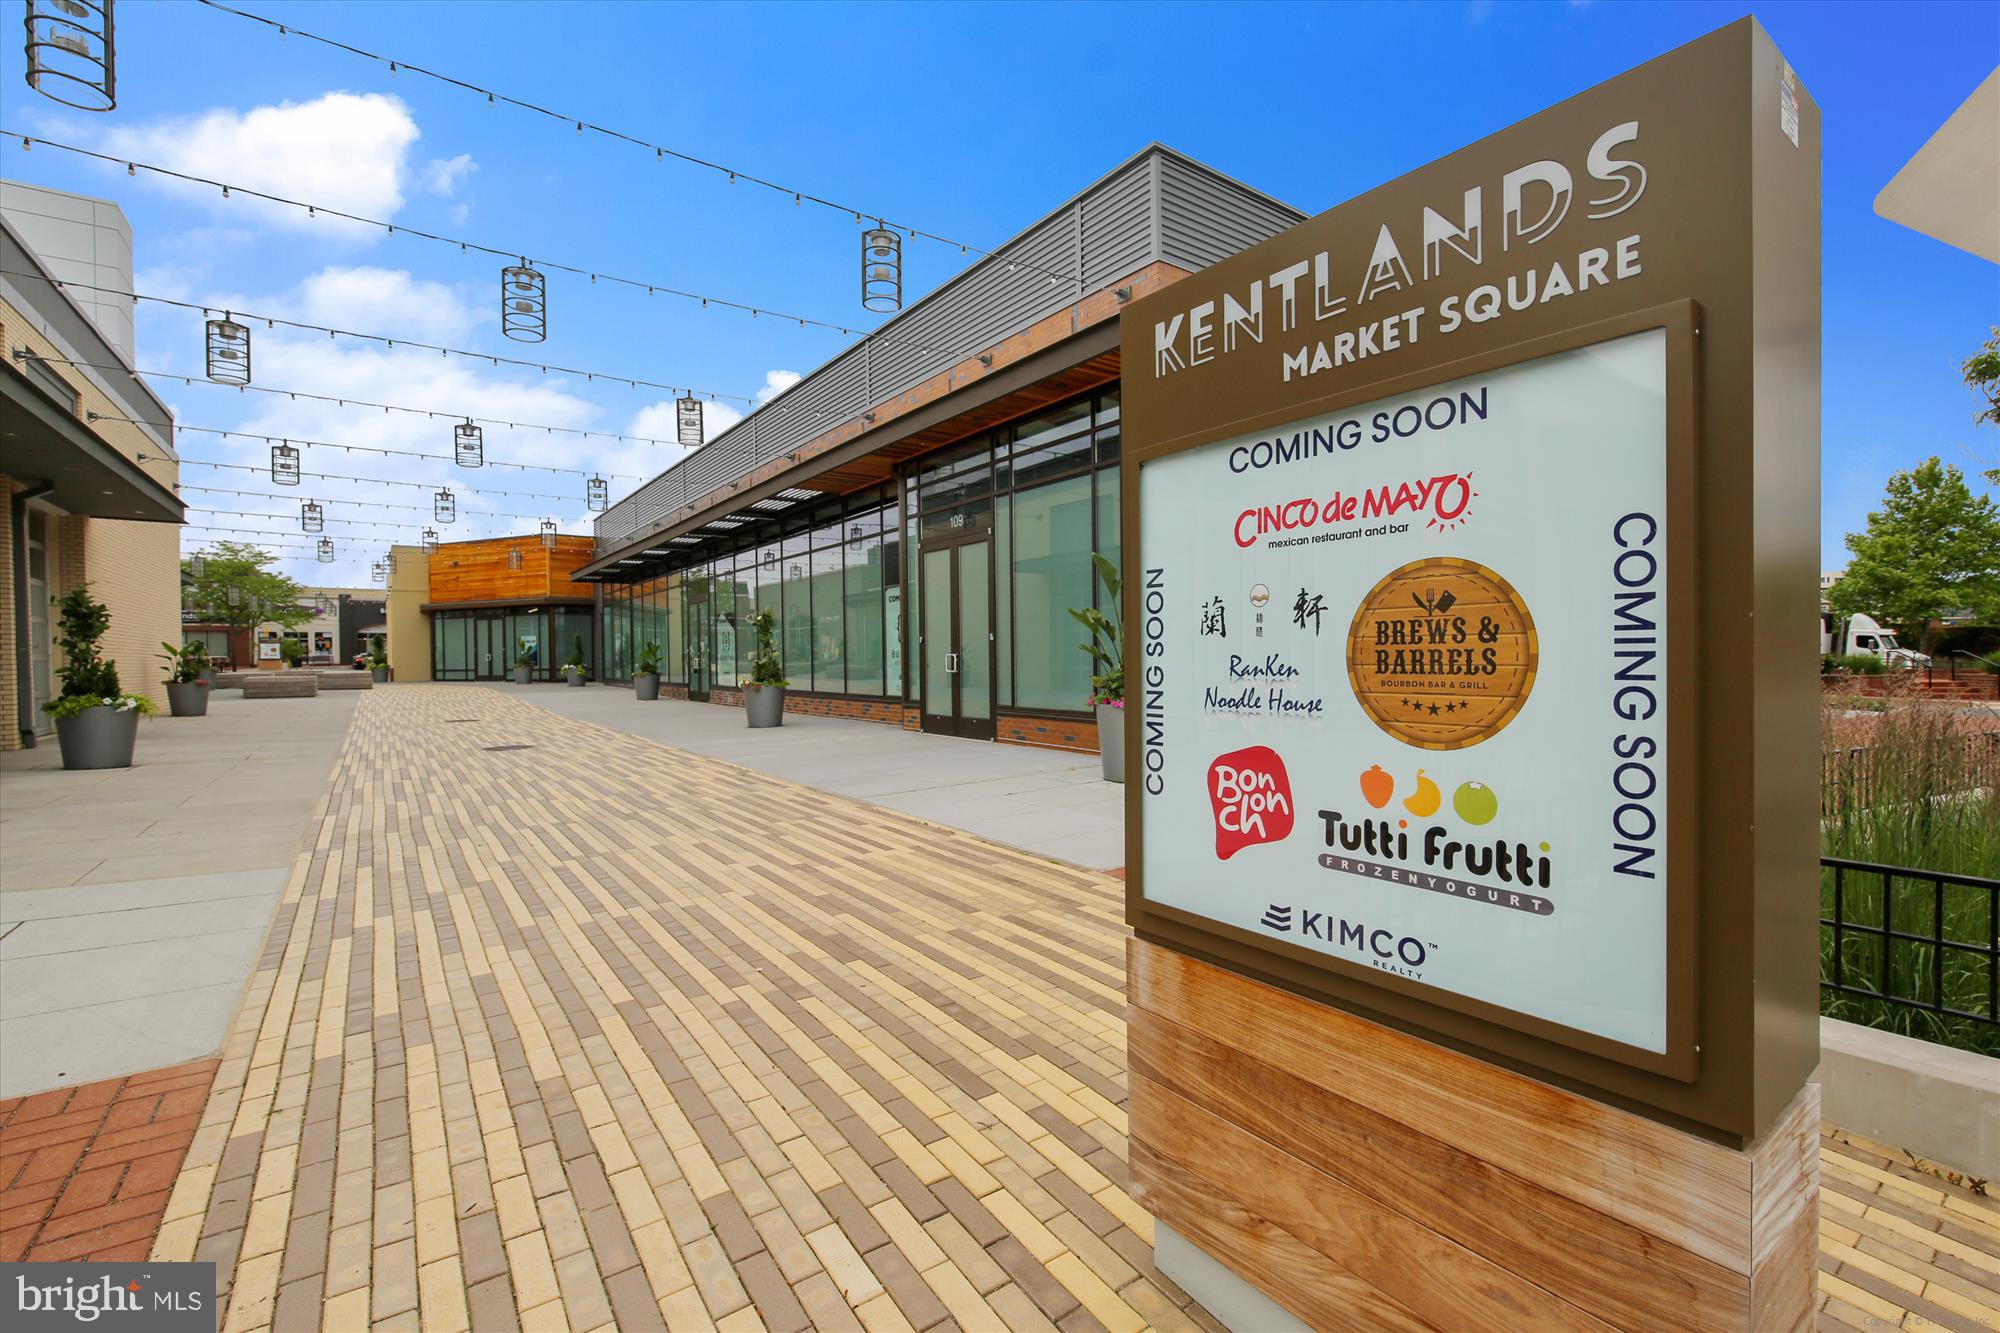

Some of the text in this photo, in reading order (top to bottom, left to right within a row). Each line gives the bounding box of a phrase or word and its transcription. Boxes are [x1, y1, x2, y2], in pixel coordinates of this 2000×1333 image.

[1154, 120, 1648, 379] KENTLANDS
[1282, 234, 1643, 382] MARKET SQUARE
[1228, 387, 1489, 474] COMING SOON
[950, 514, 964, 528] 109
[1234, 473, 1471, 548] CINCO de MAYO
[1268, 523, 1409, 549] mexican restaurant and bar
[1375, 616, 1500, 646] BREWS &
[1229, 653, 1299, 678] RanKen
[1375, 647, 1497, 676] BARRELS
[1145, 568, 1165, 796] COMING SOON
[1204, 686, 1323, 714] Noodle House
[1380, 680, 1488, 690] BOURBON BAR & GRILL
[1612, 512, 1658, 879] COMING SOON
[1215, 765, 1276, 804] Bon
[1318, 809, 1408, 861] Tutti
[1302, 909, 1427, 967] KIMCO
[1373, 959, 1423, 980] REALTY
